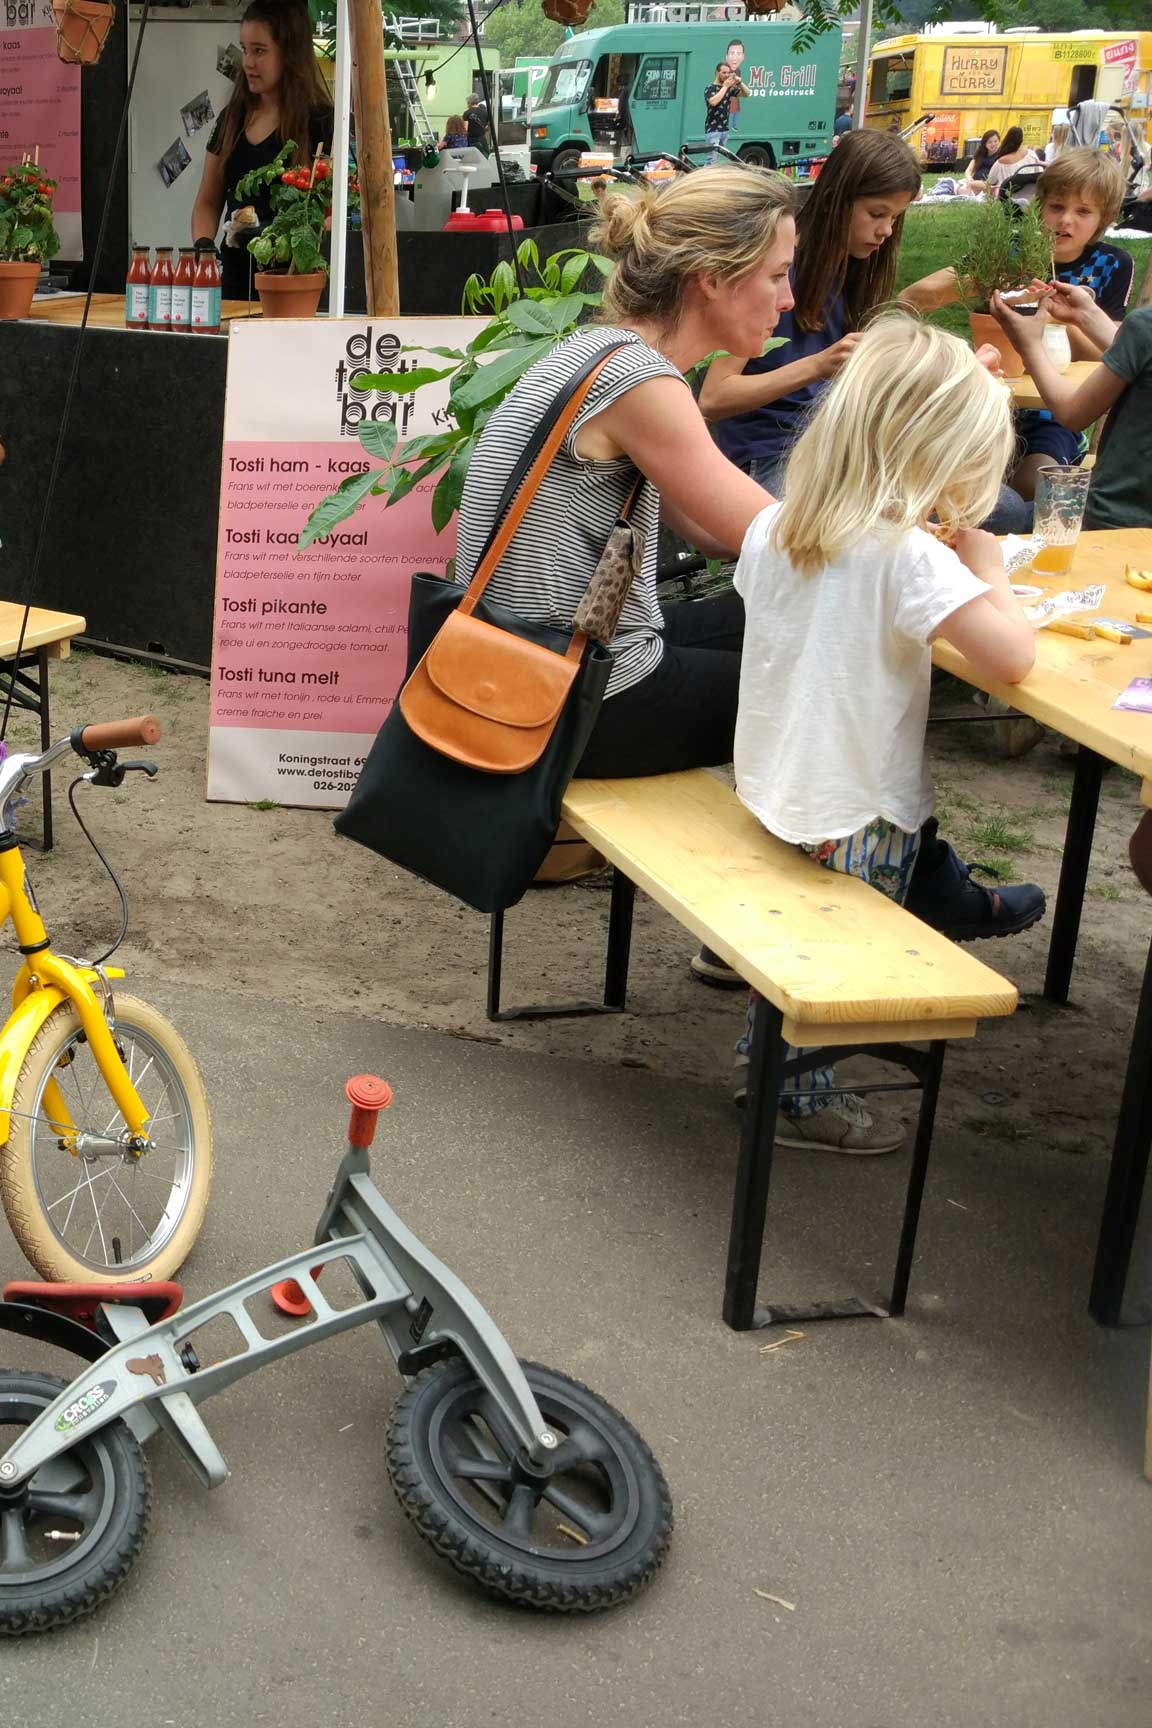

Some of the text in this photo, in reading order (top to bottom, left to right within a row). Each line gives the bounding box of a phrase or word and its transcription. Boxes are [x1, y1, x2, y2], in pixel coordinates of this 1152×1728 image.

[3, 40, 21, 50] kaas
[951, 55, 999, 71] HURRY
[749, 64, 817, 88] Mr. Grill
[949, 77, 996, 89] CURRY
[0, 85, 23, 97] royaal
[769, 88, 815, 97] foodtruck
[346, 326, 402, 366] de
[340, 393, 415, 435] bar
[229, 457, 264, 473] Tosti
[269, 457, 309, 473] ham
[327, 458, 371, 473] kaas
[227, 481, 255, 492] Frans
[256, 482, 271, 492] wit
[272, 482, 293, 492] met
[295, 482, 339, 493] boerenk
[227, 500, 315, 512] bladpeterselie en
[225, 528, 261, 544] Tosti
[266, 529, 299, 545] kaa
[224, 551, 250, 561] Frans
[252, 552, 267, 562] wit
[268, 552, 289, 562] met
[291, 552, 358, 563] verschillende
[359, 554, 399, 564] soorten
[223, 570, 361, 583] bladpeterselie en tijm boter
[222, 597, 328, 616] Tosti pikante
[220, 620, 247, 630] Frans
[248, 620, 263, 630] wit
[264, 621, 285, 631] met
[286, 622, 336, 633] Italiaanse
[374, 624, 394, 634] chili
[219, 638, 244, 649] rode
[245, 640, 255, 649] ui
[271, 640, 347, 653] zongedroogde
[349, 642, 390, 653] tomaat.
[218, 666, 340, 686] Tosti tuna melt
[217, 689, 243, 699] Frans
[244, 690, 260, 700] wit
[261, 690, 282, 701] met
[283, 691, 311, 703] tonijn
[316, 693, 342, 703] rode
[216, 708, 249, 717] creme
[251, 708, 286, 719] fraiche
[287, 711, 301, 719] en
[278, 753, 351, 767] Koningstraat
[64, 1385, 104, 1422] CROSS
